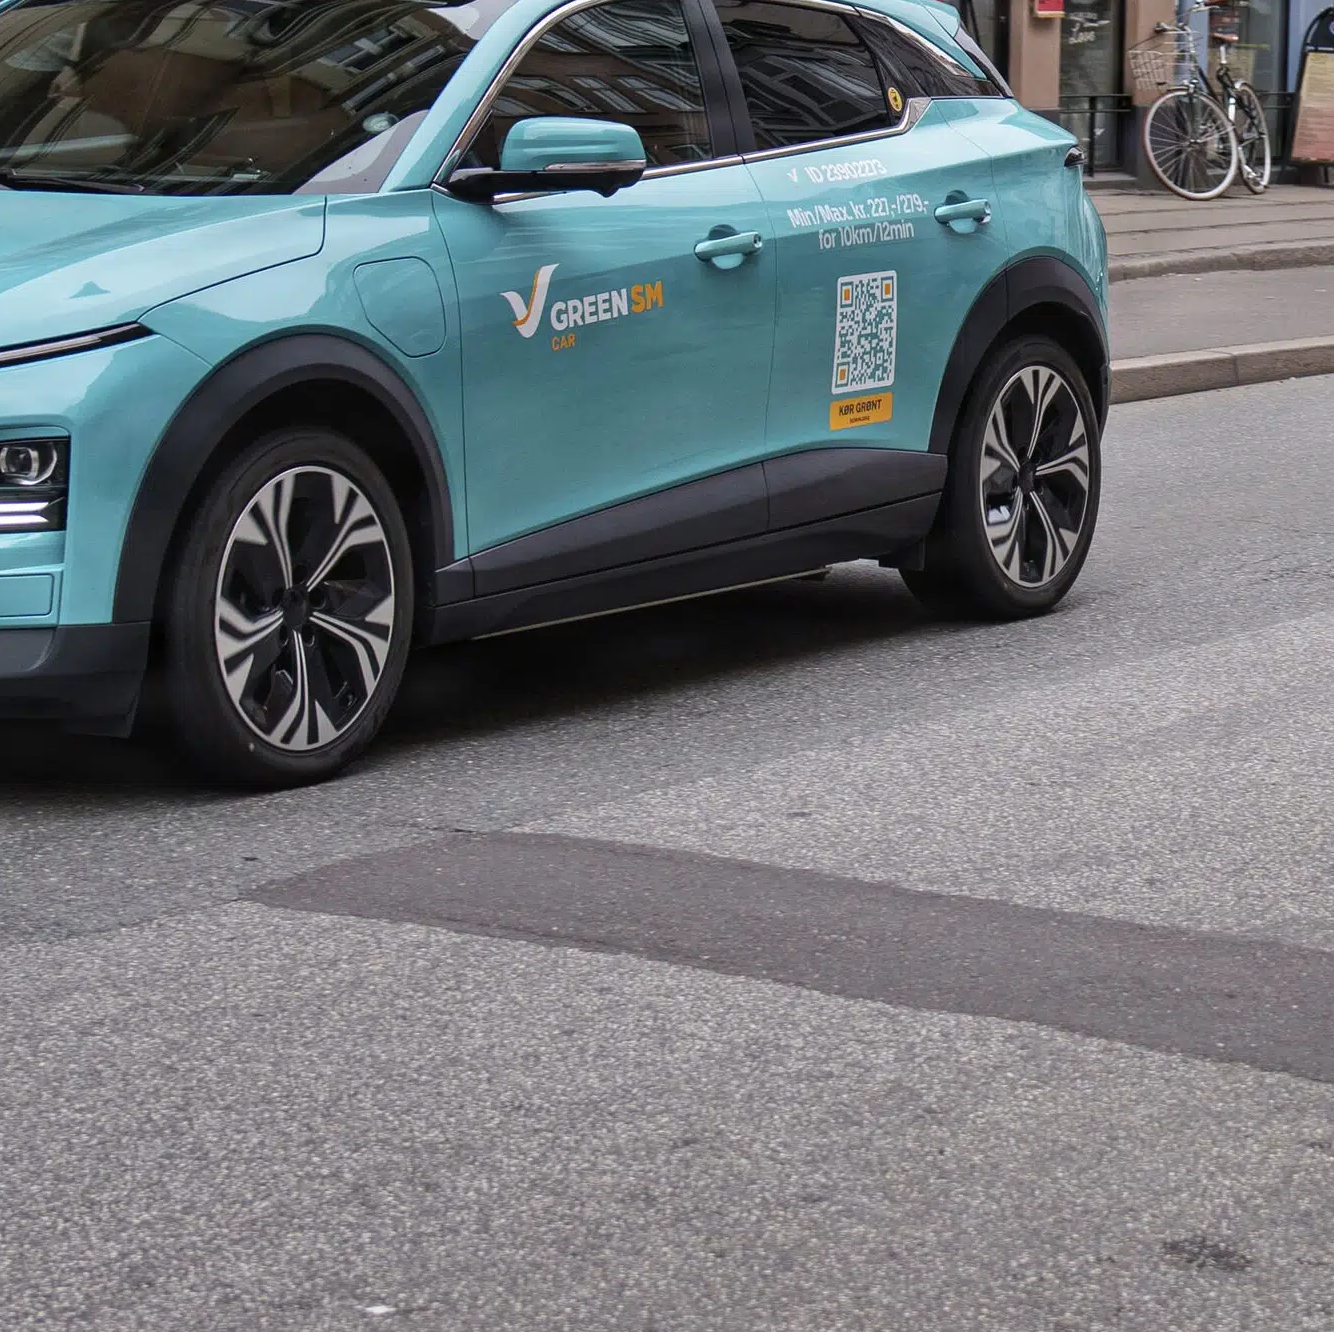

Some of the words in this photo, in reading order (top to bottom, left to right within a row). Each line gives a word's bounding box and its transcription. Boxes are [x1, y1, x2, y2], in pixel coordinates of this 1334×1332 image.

[804, 166, 824, 184] ID
[823, 159, 888, 182] 23902273
[787, 204, 853, 228] Min/Max.
[850, 201, 870, 219] kr.
[819, 229, 837, 250] for
[839, 220, 915, 247] 10km/12min
[550, 288, 629, 331] GREEN
[631, 281, 664, 313] SM
[551, 333, 576, 352] CAR
[839, 404, 854, 416] KØR
[856, 399, 882, 413] GRØNT
